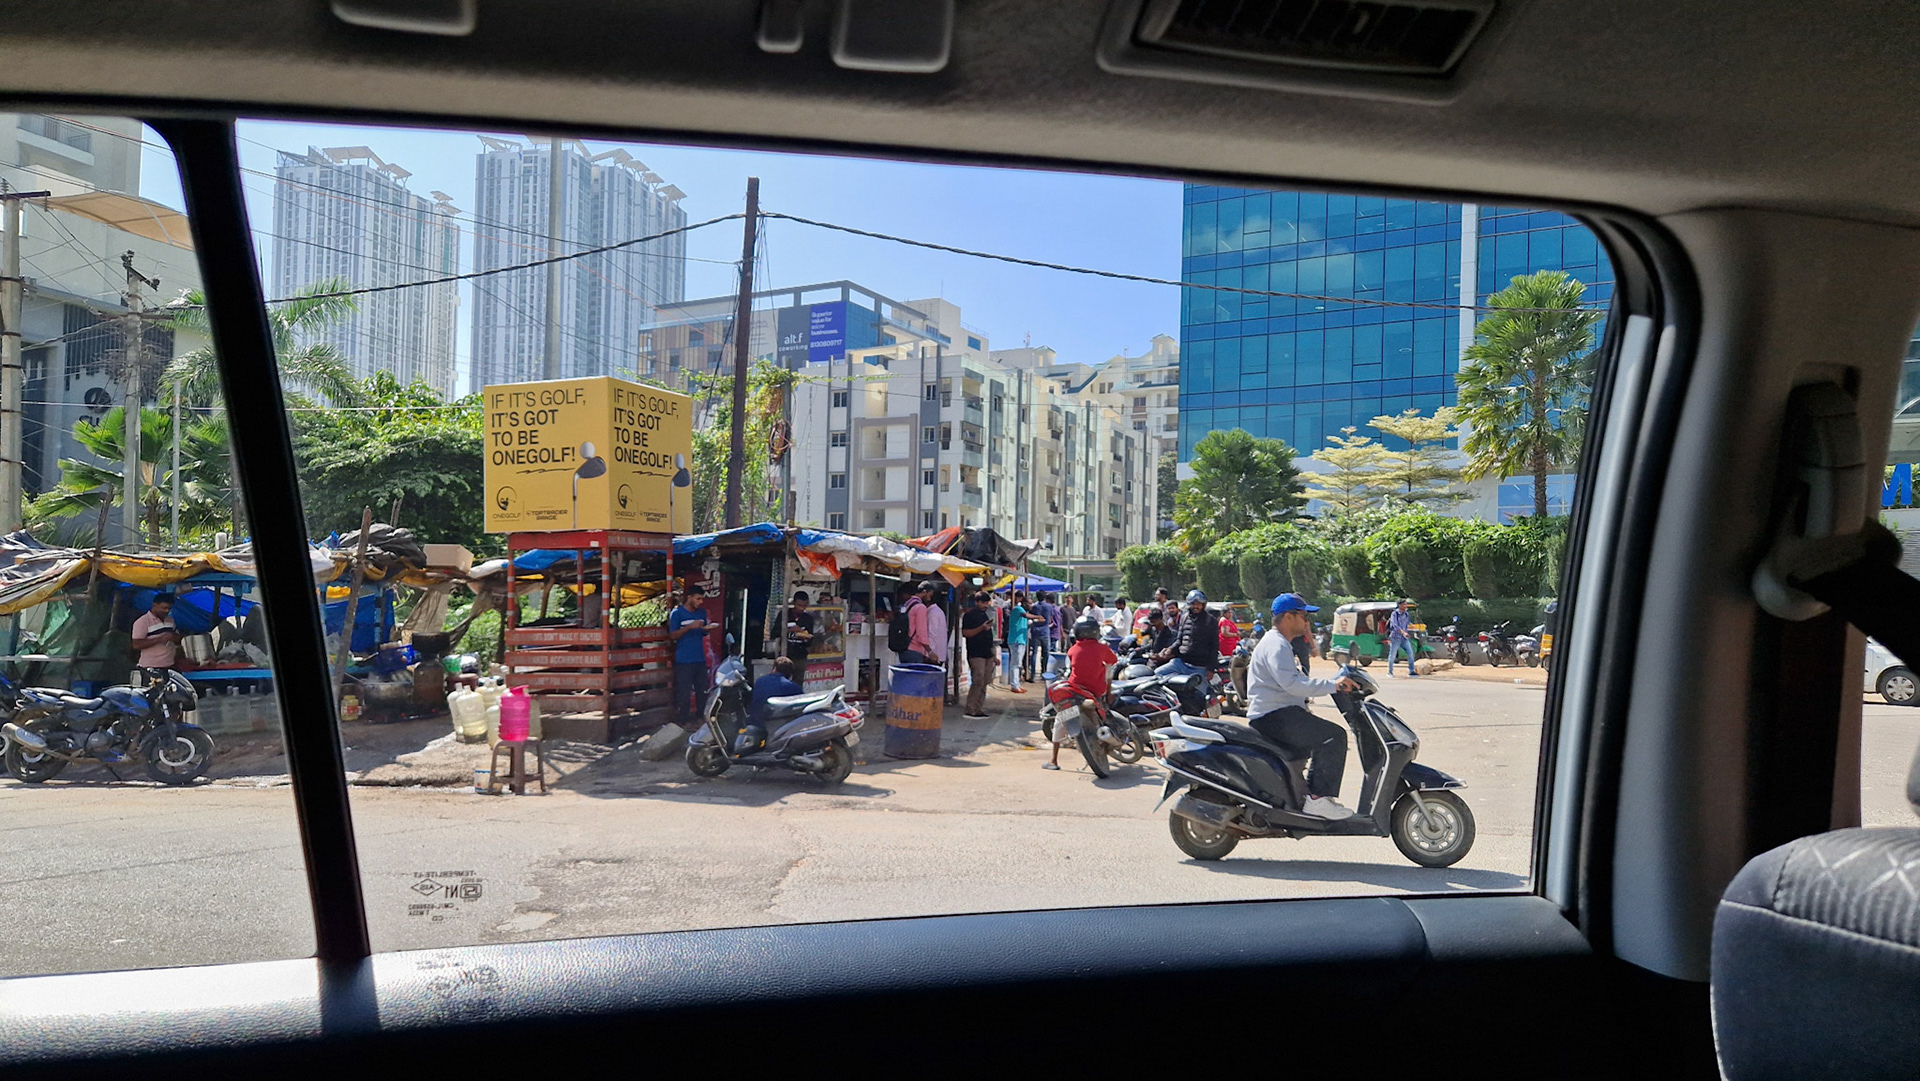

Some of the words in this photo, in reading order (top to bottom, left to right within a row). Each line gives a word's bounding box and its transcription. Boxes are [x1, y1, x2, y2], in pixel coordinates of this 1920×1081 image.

[778, 344, 808, 352] coworking
[491, 394, 505, 409] IF
[509, 391, 536, 408] IT'S
[540, 388, 586, 406] GOLF,
[613, 387, 624, 404] IF
[626, 391, 647, 410] IT'S
[649, 396, 679, 420] GOLF,
[491, 411, 520, 428] IT'S
[524, 409, 559, 426] GOT
[613, 407, 635, 426] IT'S
[637, 412, 661, 431] GOT
[491, 431, 513, 447] TO
[518, 429, 539, 445] BE
[614, 426, 630, 444] TO
[633, 430, 649, 448] BE
[492, 446, 575, 466] ONEGOLF!
[614, 447, 672, 470] ONEGOLF!
